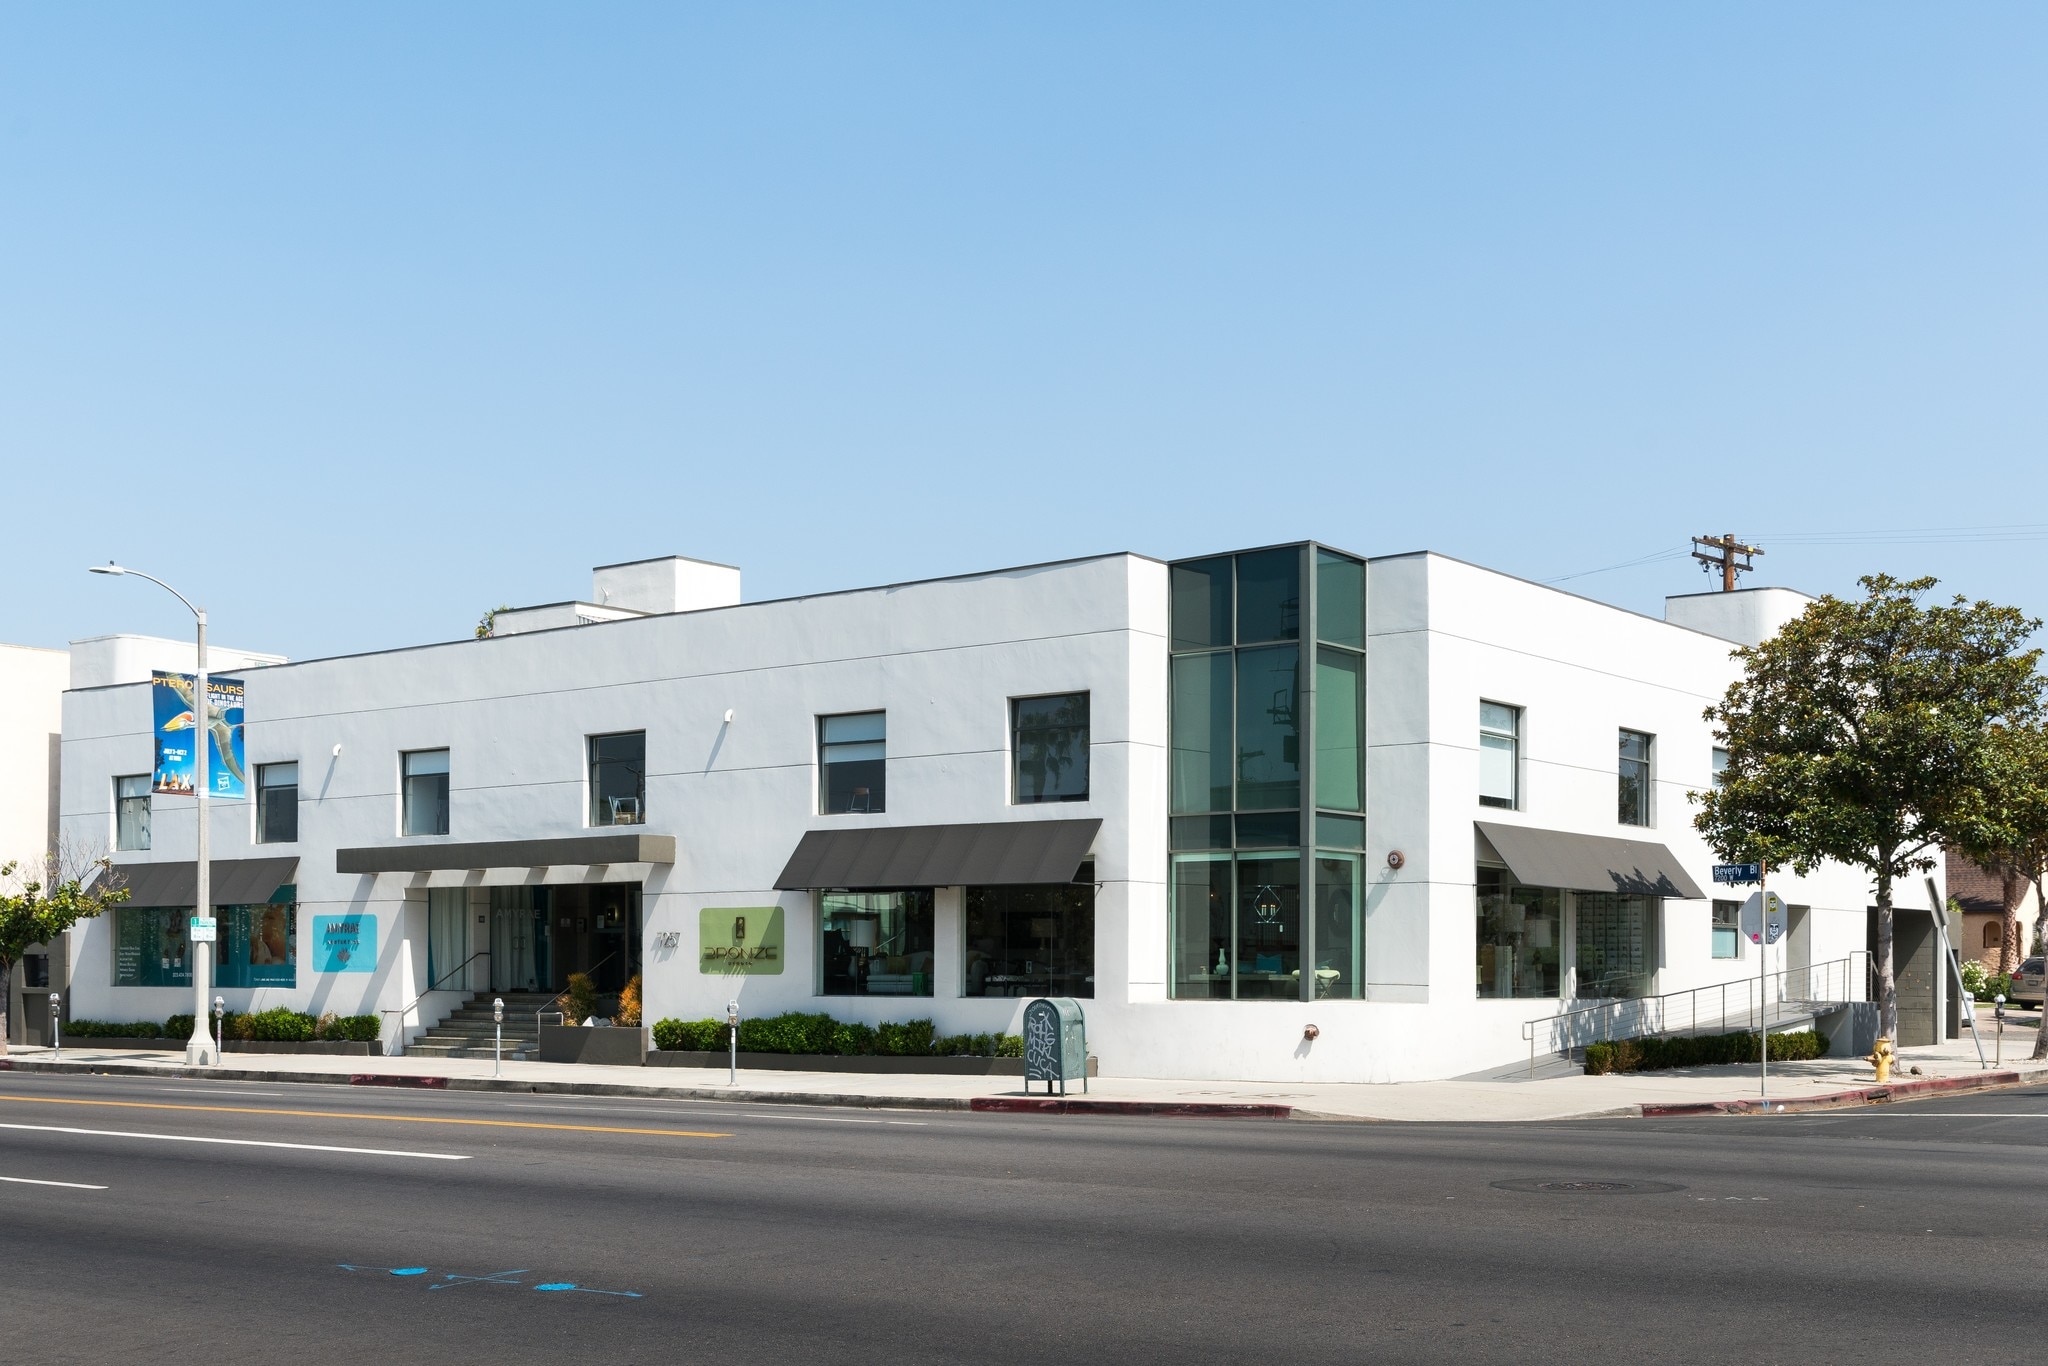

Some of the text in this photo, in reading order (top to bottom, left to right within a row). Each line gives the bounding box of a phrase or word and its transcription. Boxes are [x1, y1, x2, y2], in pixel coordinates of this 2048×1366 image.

[153, 677, 244, 696] PTERO SAURS
[159, 772, 192, 791] LAX
[1714, 865, 1757, 877] Beverly Bl
[496, 909, 541, 919] AMYRAE
[704, 946, 777, 960] BRONZE
